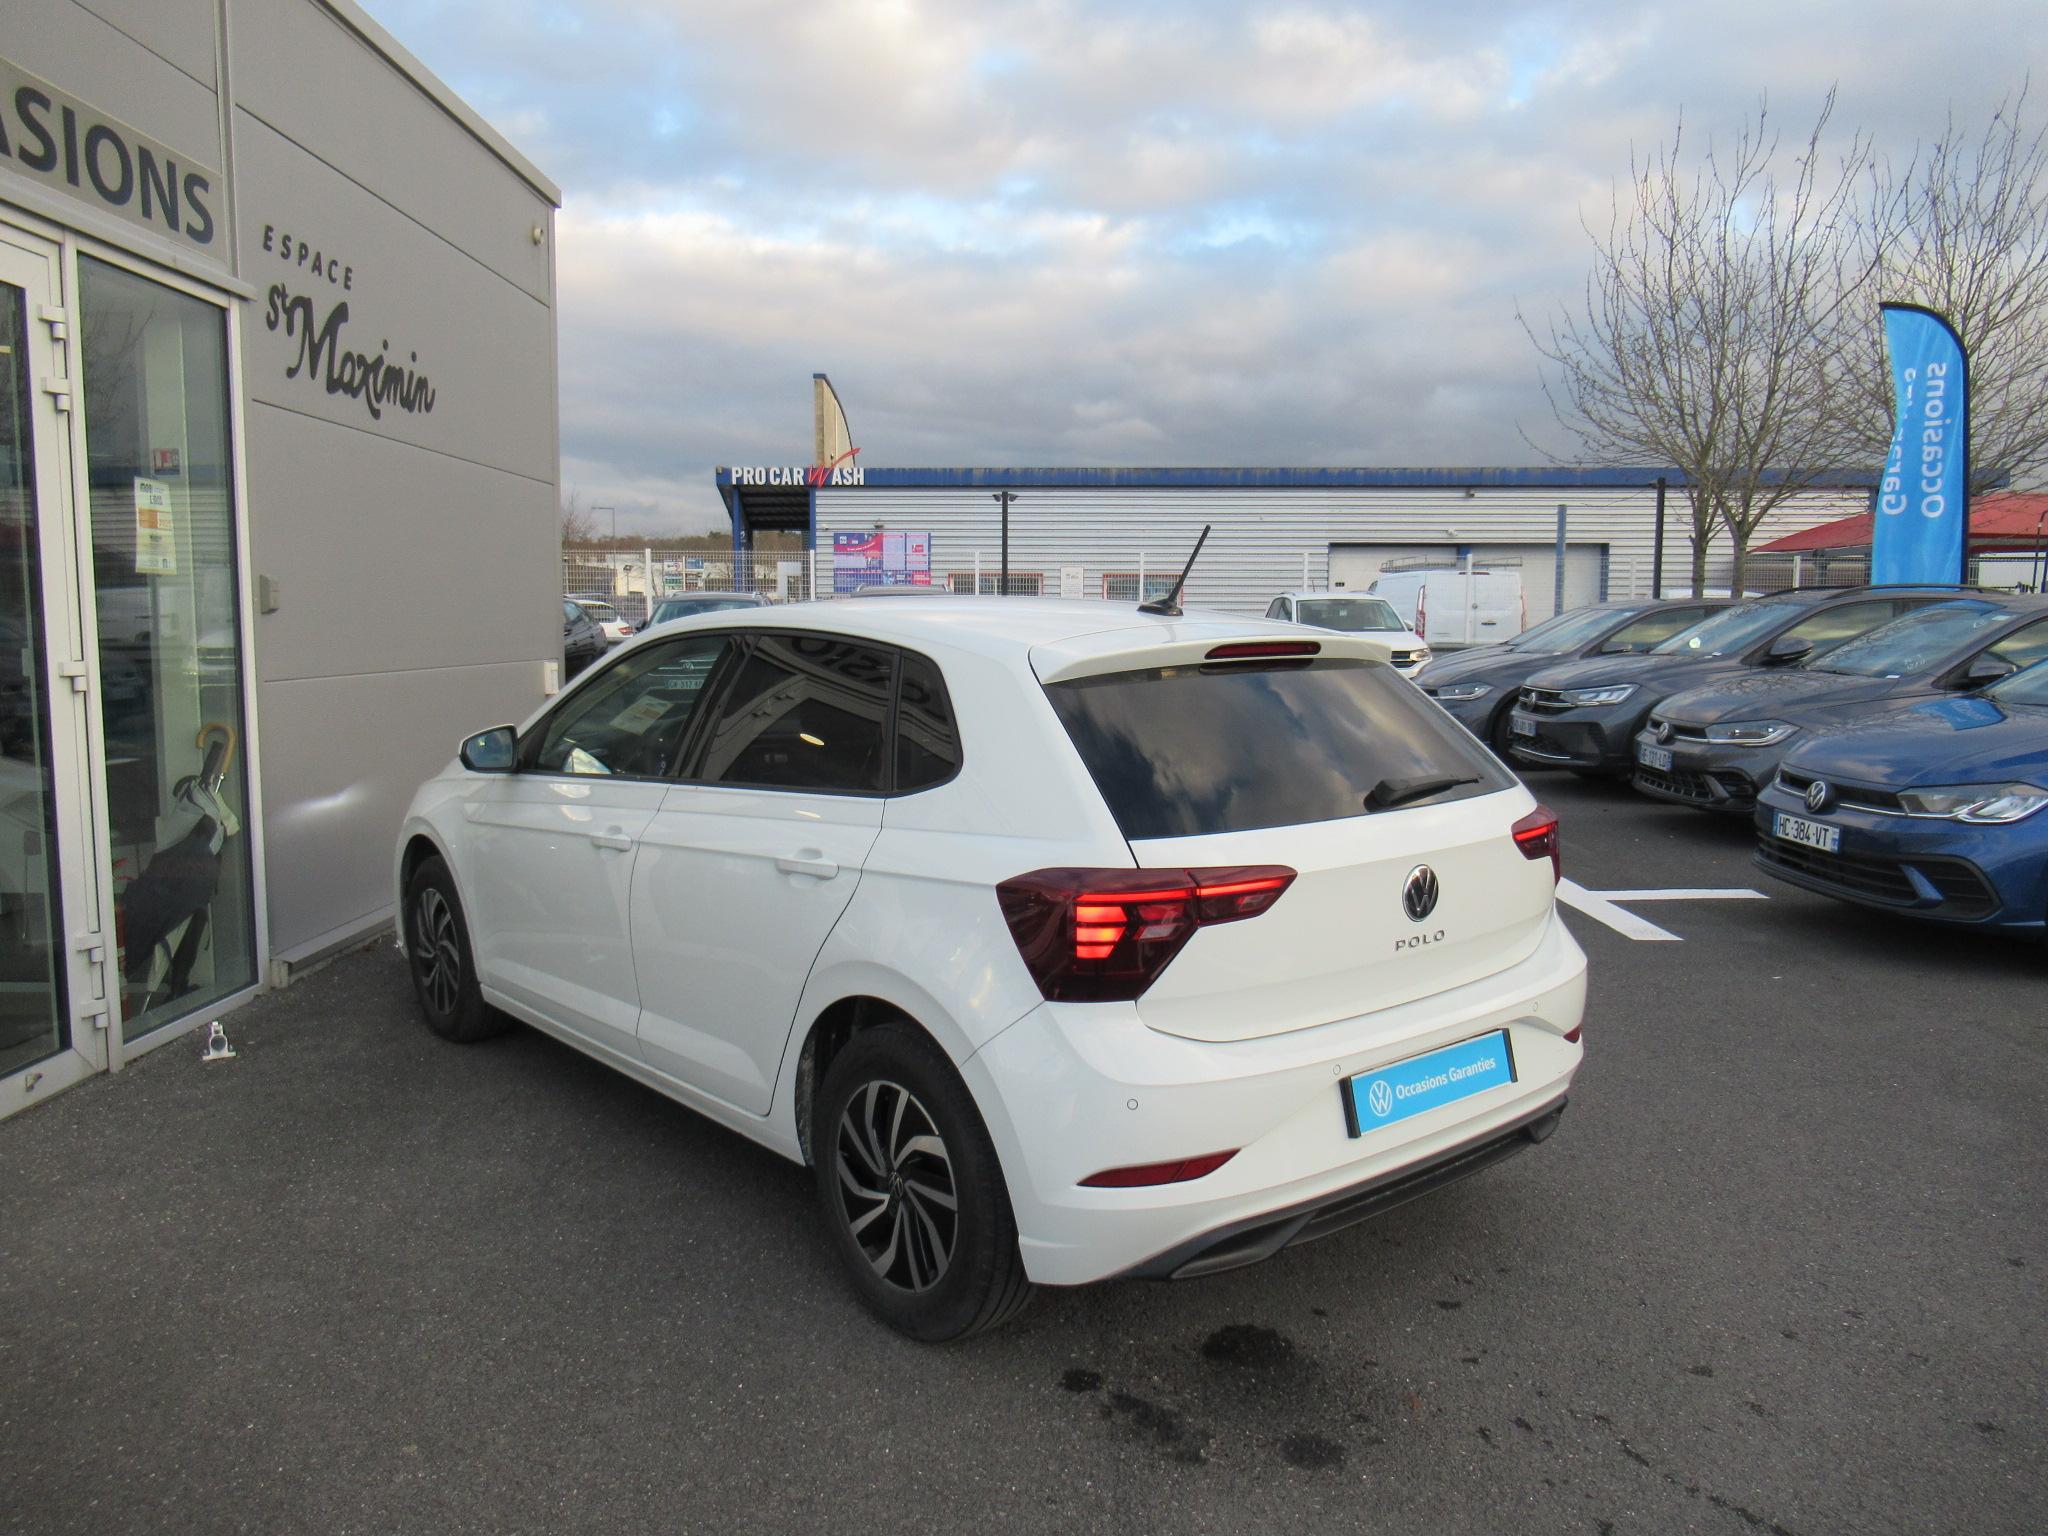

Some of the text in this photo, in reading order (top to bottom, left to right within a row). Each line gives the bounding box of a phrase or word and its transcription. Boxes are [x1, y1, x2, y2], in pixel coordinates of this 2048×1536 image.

[0, 86, 214, 244] SIONS
[263, 224, 353, 290] ESPACE
[286, 295, 436, 420] Maximin
[731, 448, 865, 488] PRO CAR WASH
[1395, 929, 1445, 951] POLO
[1396, 1075, 1448, 1099] Occasions
[1449, 1057, 1496, 1082] Garanties
